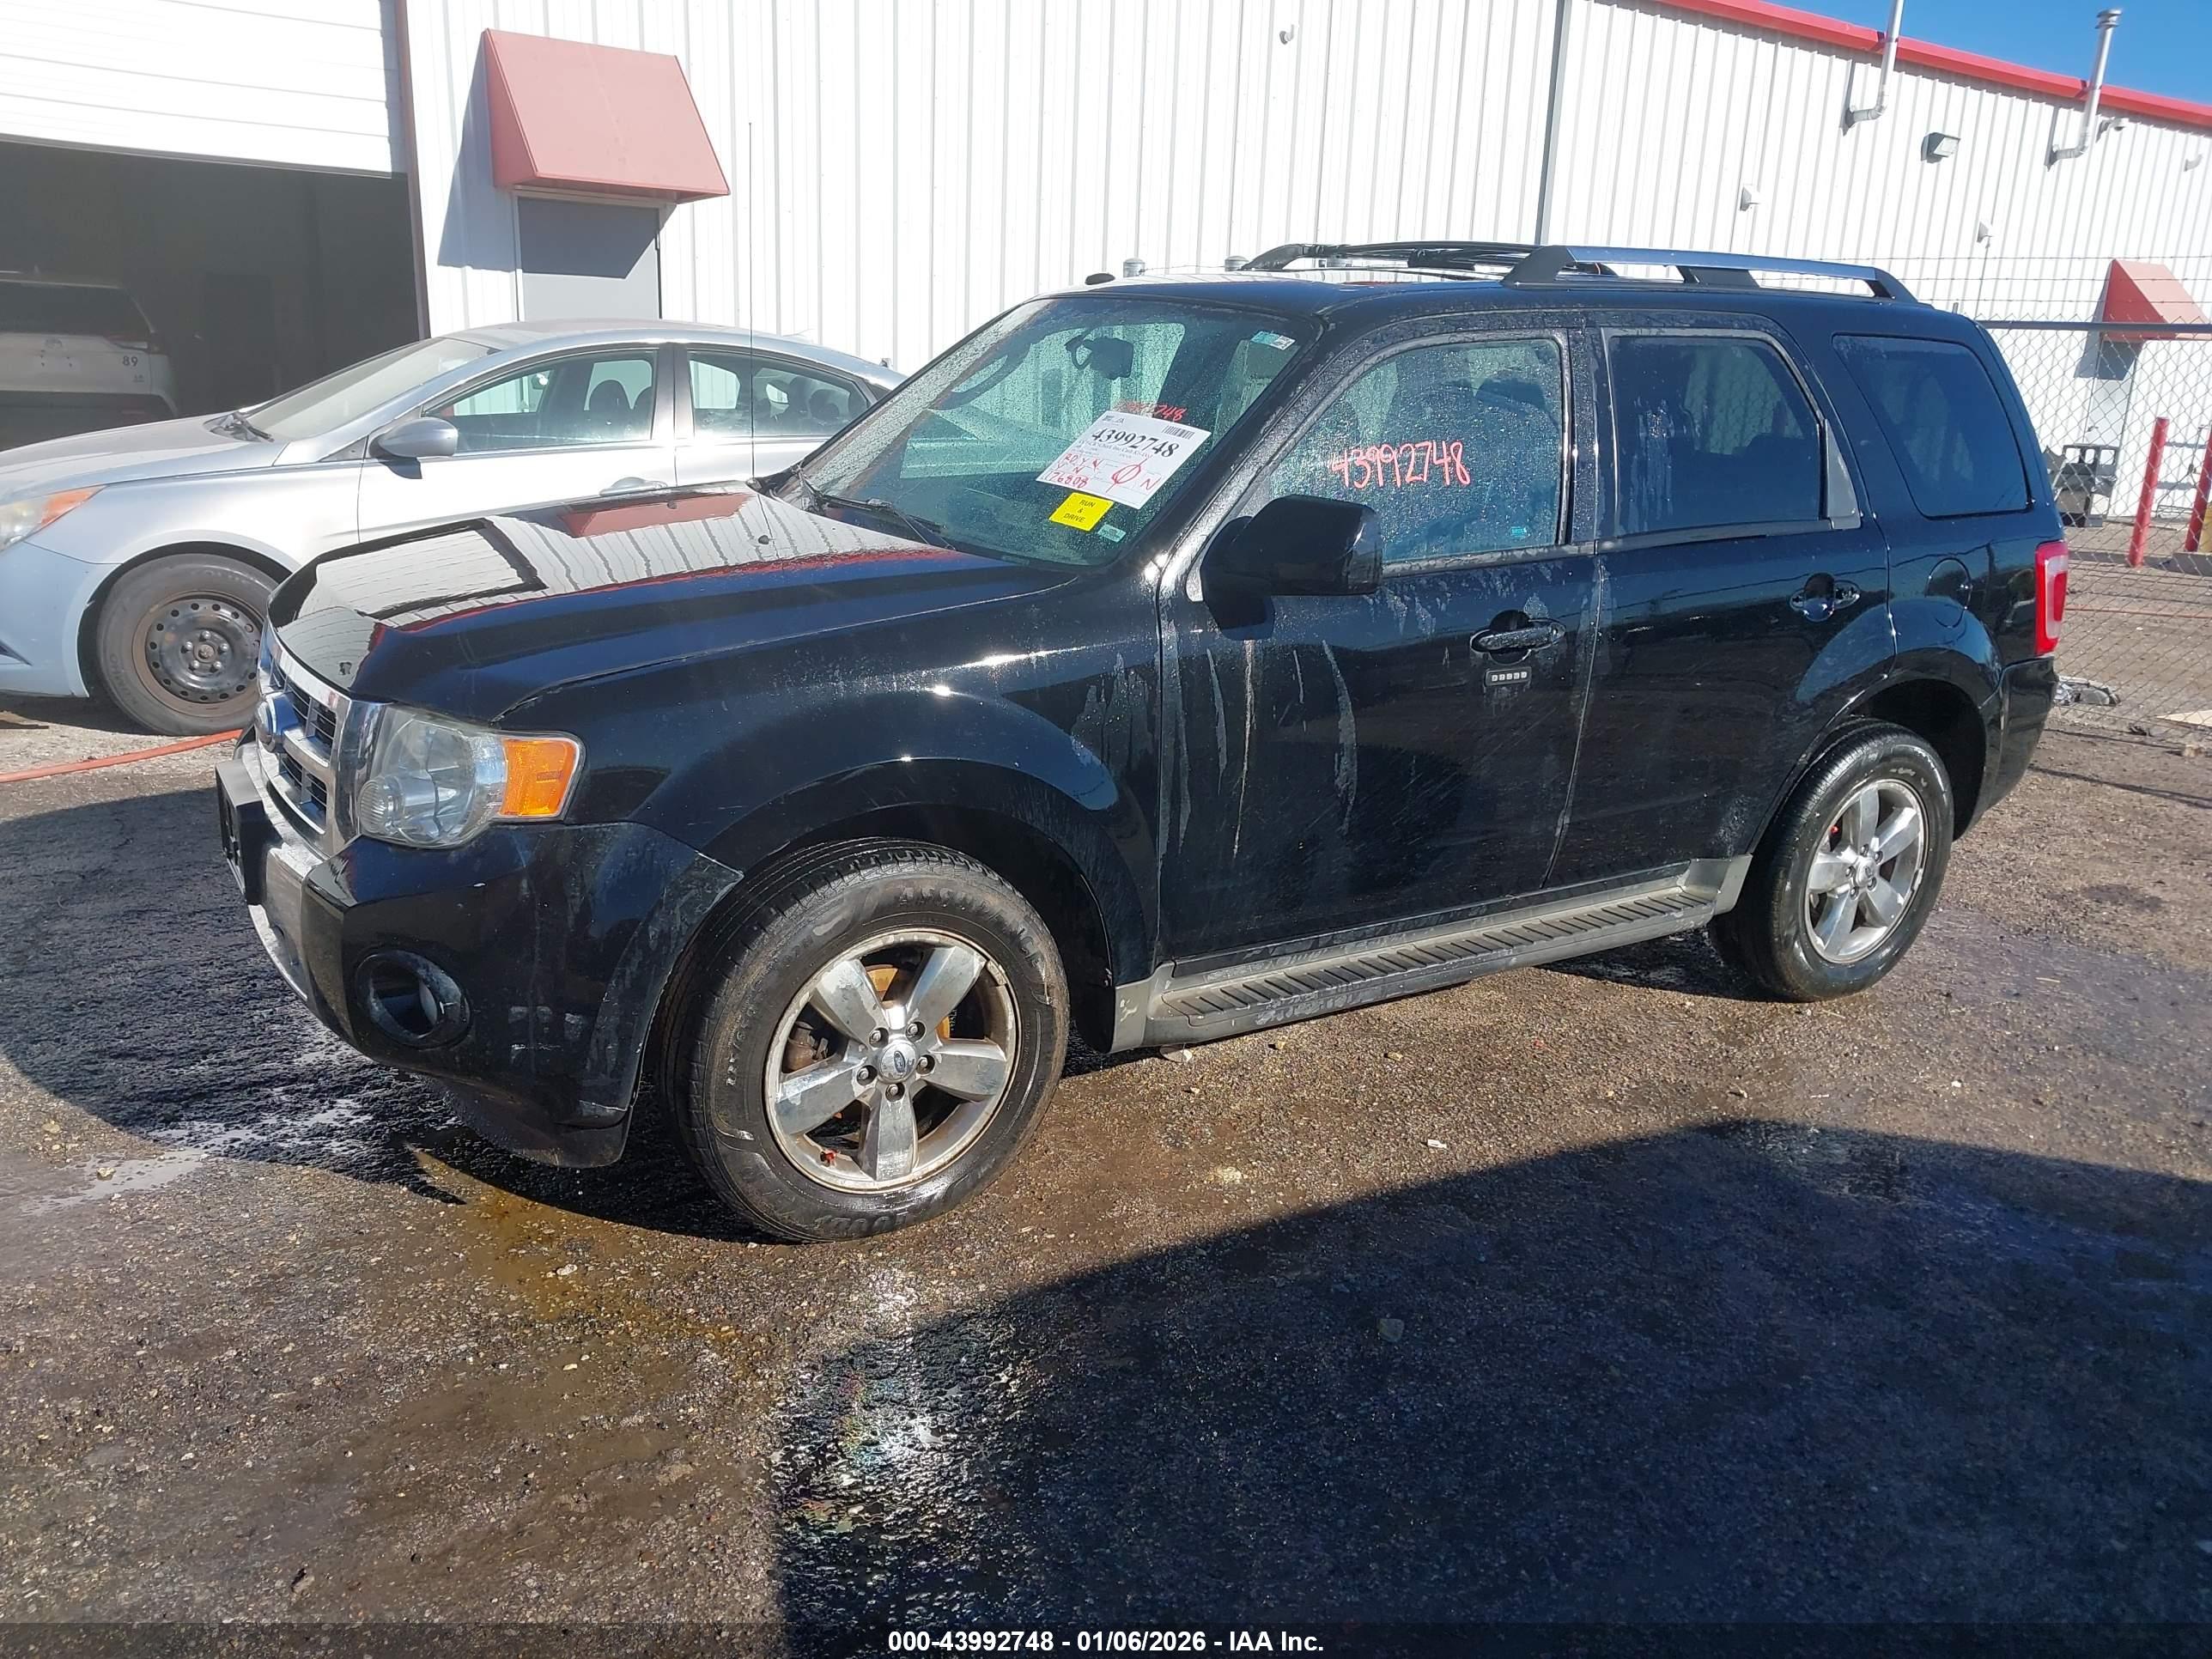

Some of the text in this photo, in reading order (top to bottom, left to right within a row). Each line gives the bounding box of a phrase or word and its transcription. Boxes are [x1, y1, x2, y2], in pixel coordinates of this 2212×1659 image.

[1091, 427, 1180, 459] 43992748
[1331, 440, 1471, 489] 43992748
[1079, 499, 1097, 507] RUN
[1063, 513, 1086, 523] DRIVE
